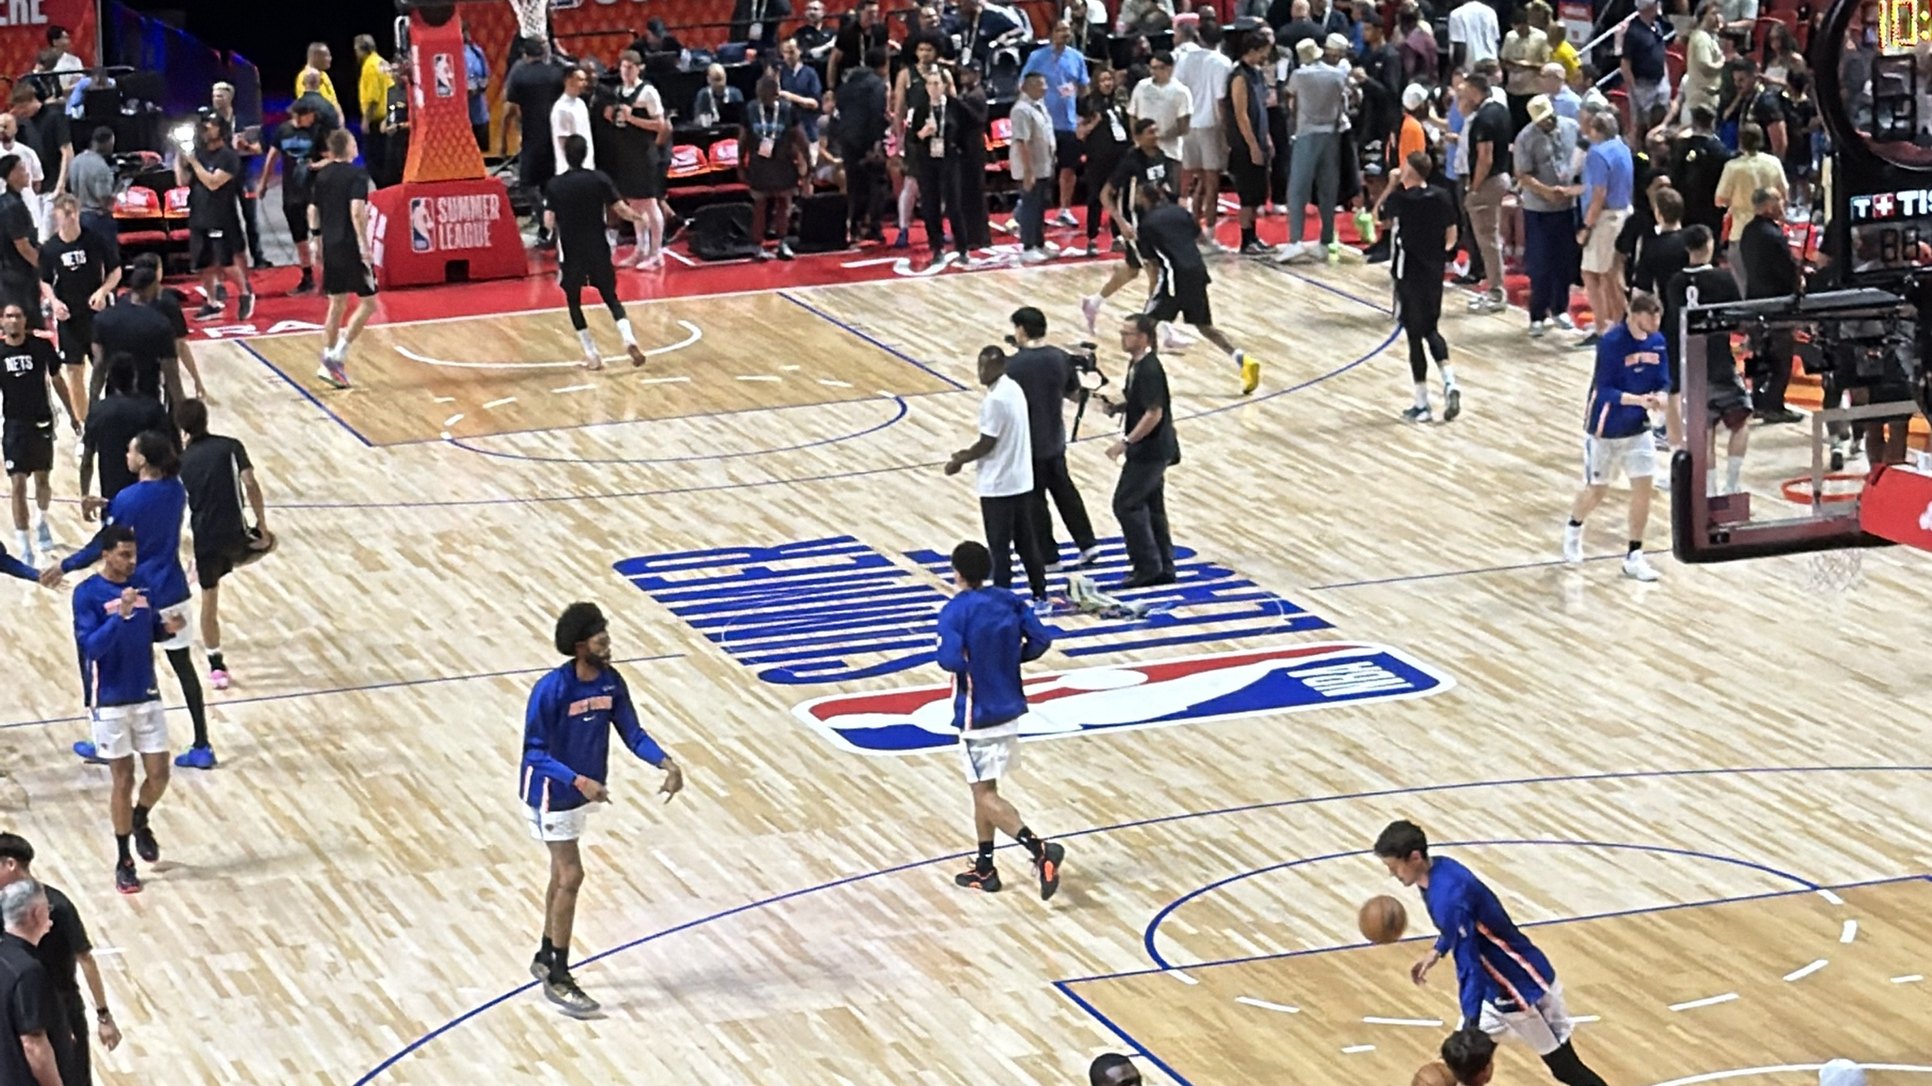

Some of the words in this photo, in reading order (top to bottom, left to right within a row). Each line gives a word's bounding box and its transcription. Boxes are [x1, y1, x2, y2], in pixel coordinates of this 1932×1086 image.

[437, 194, 500, 224] SUMMER
[438, 219, 493, 251] LEAGUE
[4, 355, 34, 372] NETS
[1286, 660, 1416, 698] NBA
